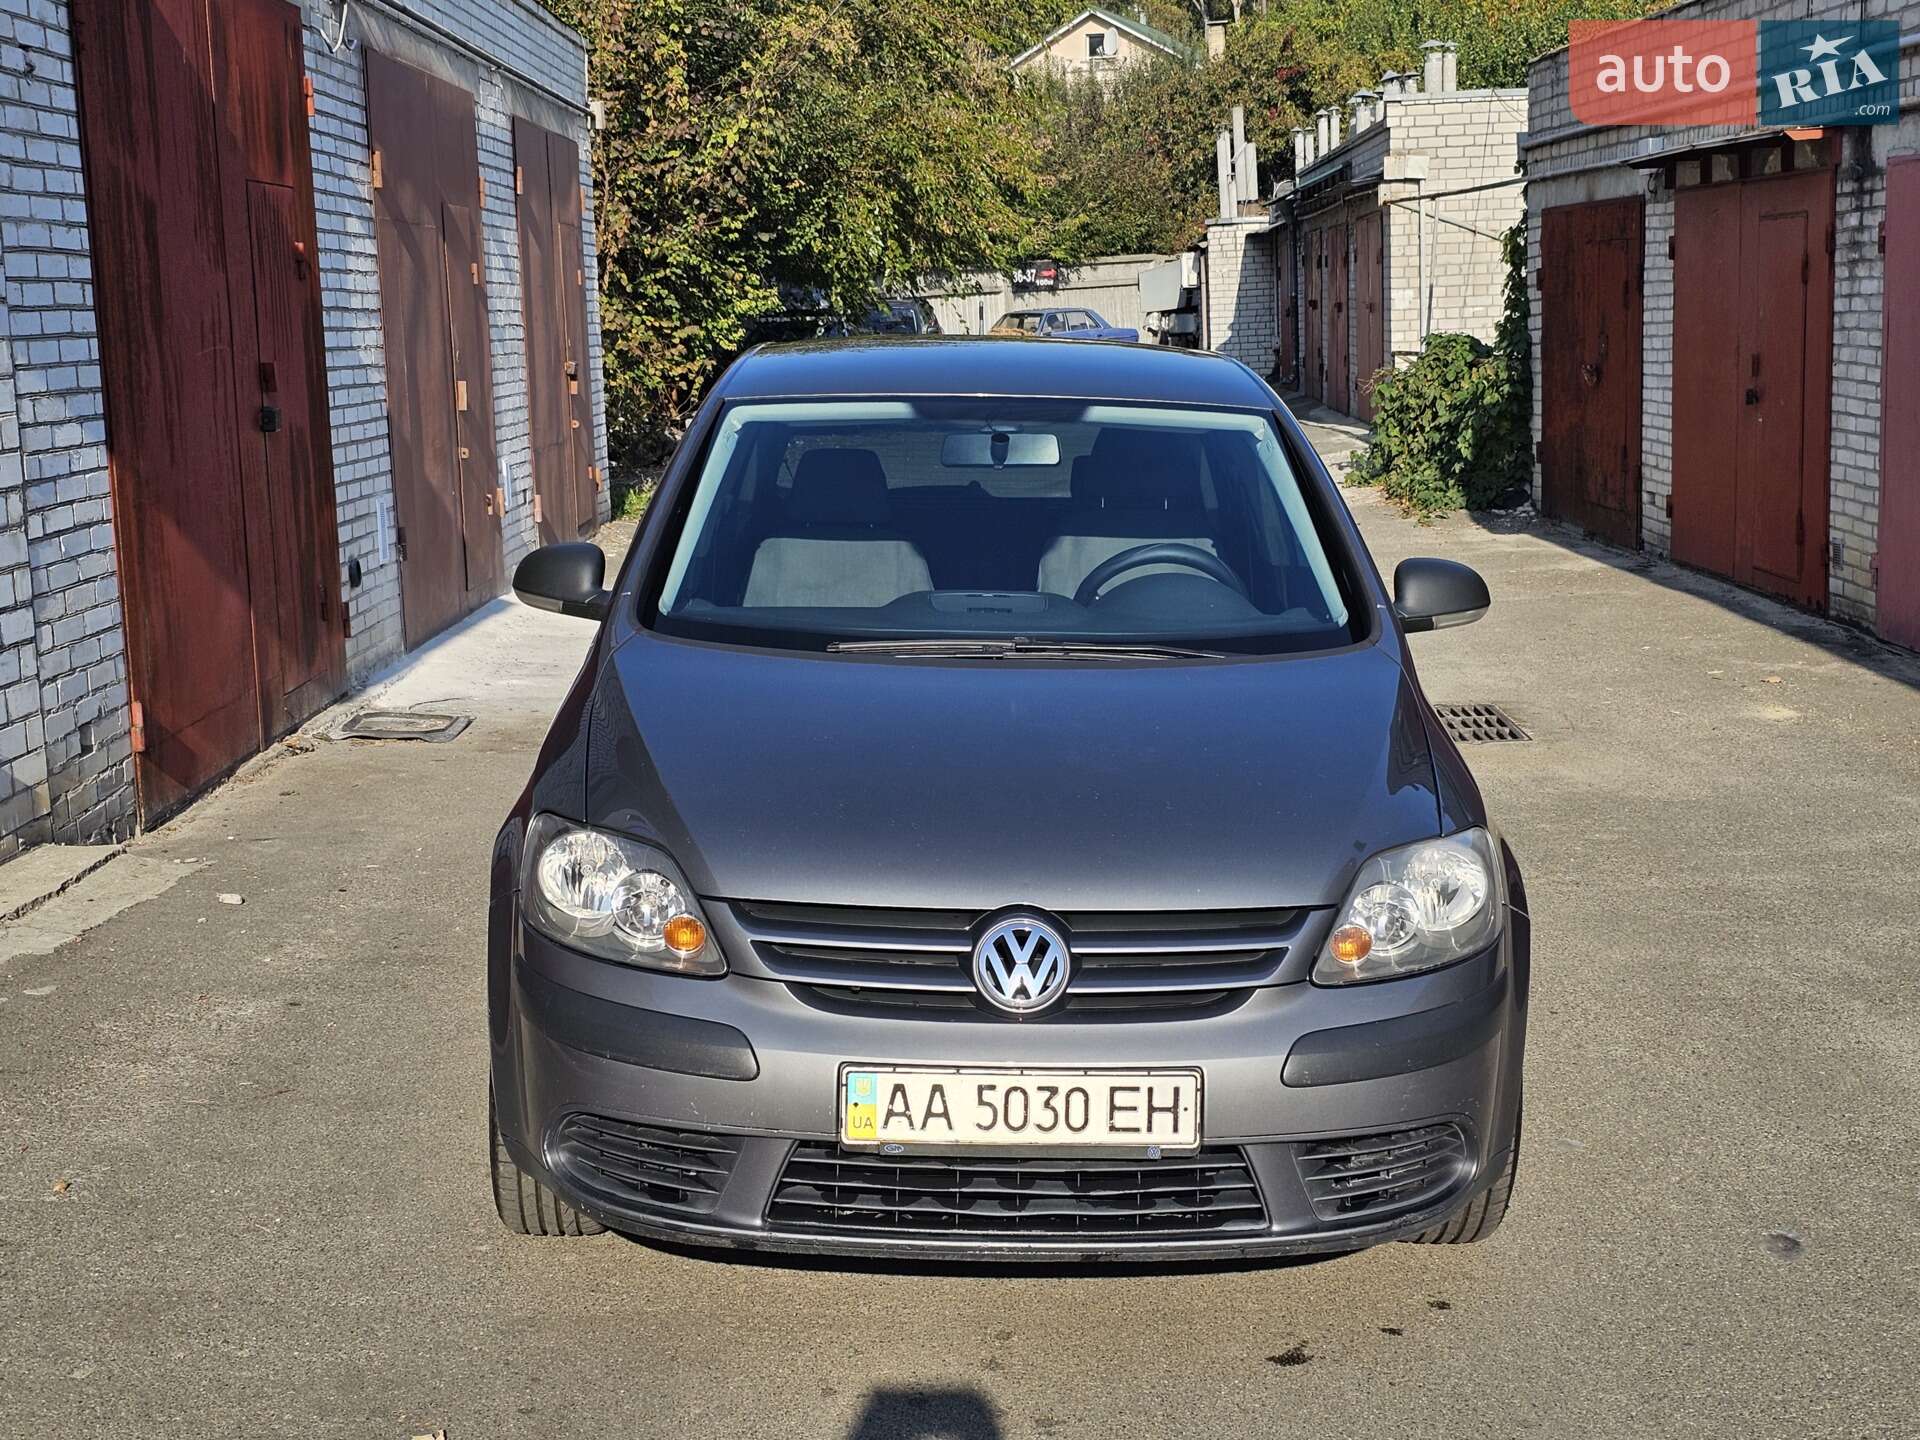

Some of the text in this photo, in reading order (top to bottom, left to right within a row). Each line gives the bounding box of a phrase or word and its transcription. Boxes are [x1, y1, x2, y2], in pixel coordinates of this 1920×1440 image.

[1012, 269, 1036, 283] 36-37
[882, 1083, 1180, 1134] AA 5030 EH
[852, 1116, 874, 1130] UA
